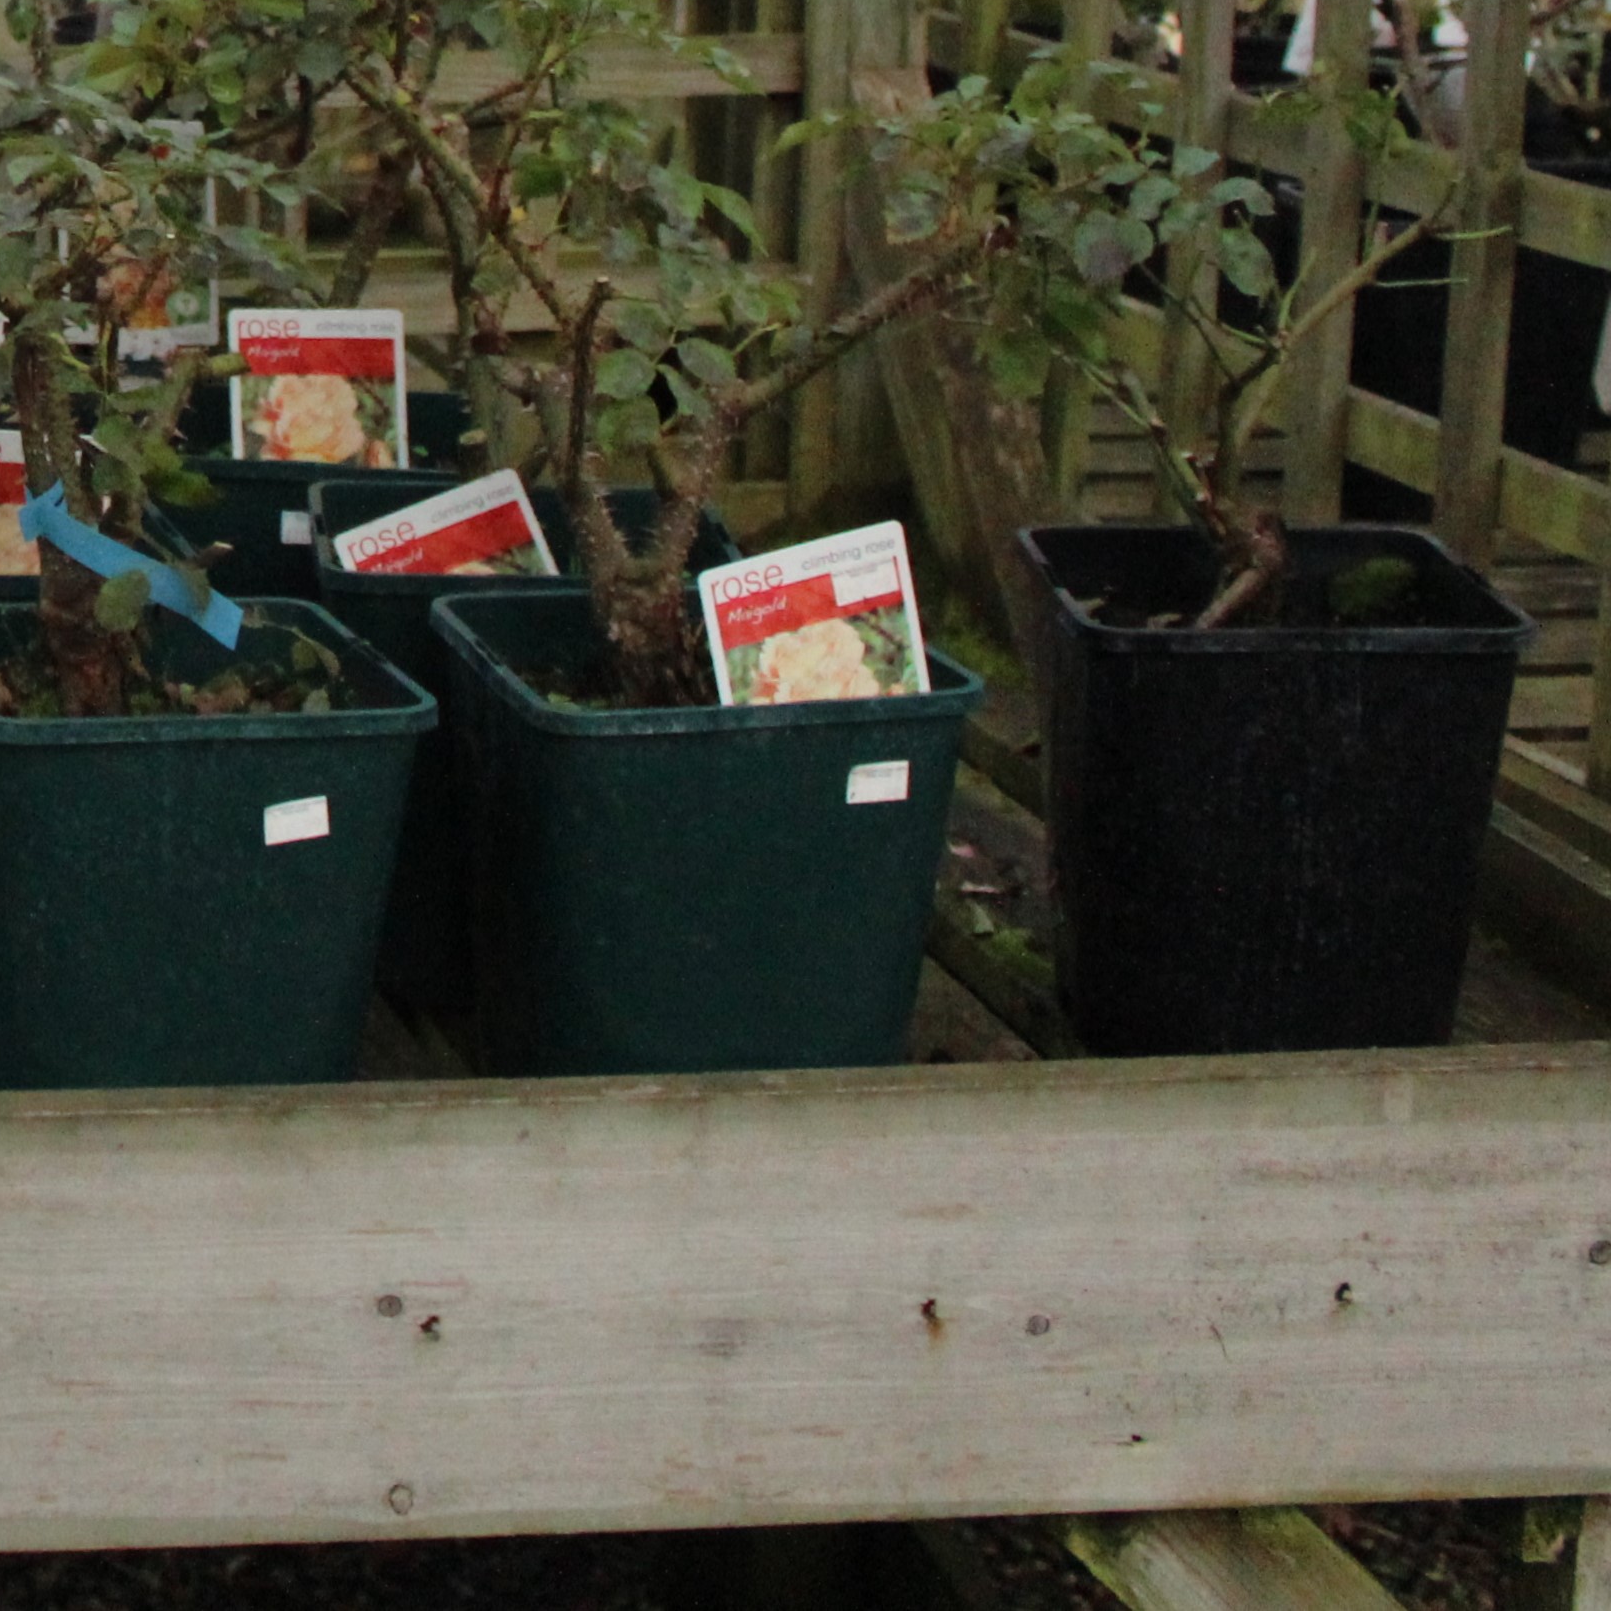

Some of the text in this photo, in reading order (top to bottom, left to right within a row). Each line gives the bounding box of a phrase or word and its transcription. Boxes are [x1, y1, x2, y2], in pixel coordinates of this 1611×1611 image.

[238, 319, 300, 339] rose
[348, 521, 416, 563] rose
[711, 564, 784, 603] rose
[801, 546, 861, 571] climbing
[865, 538, 896, 553] rose
